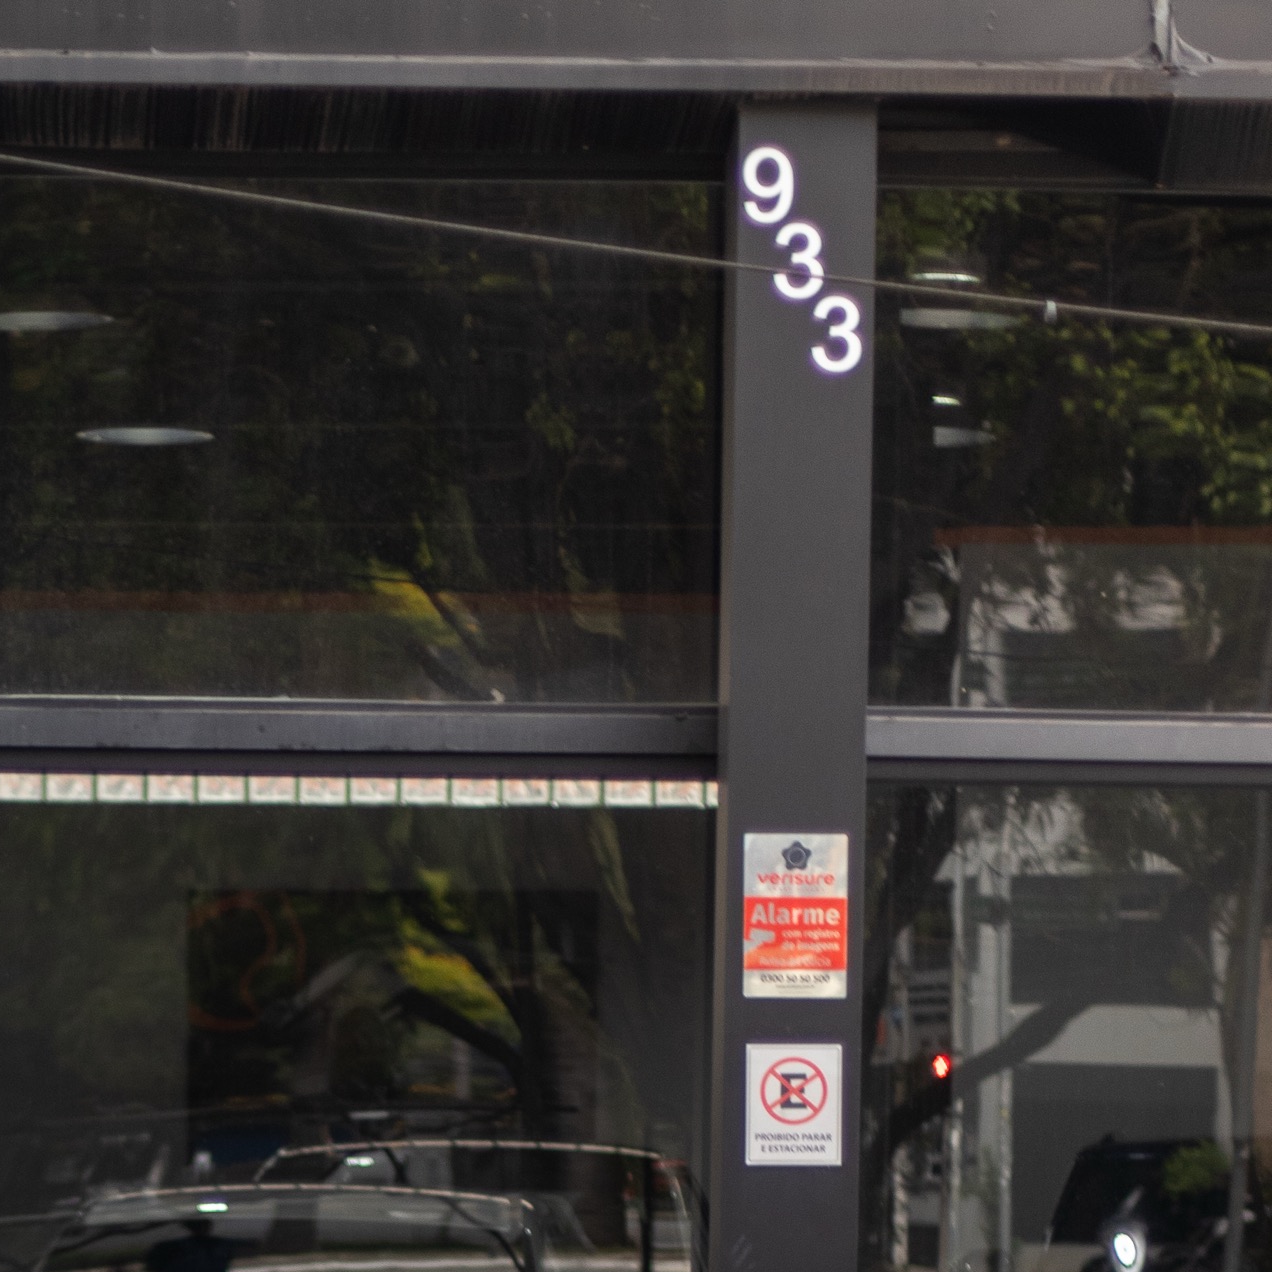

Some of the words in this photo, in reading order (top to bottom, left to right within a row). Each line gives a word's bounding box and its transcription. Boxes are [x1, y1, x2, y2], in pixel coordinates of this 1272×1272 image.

[742, 146, 863, 373] 933
[757, 872, 835, 885] verisure
[750, 903, 841, 926] Alarme
[755, 1133, 800, 1142] PROIBIDO
[802, 1133, 832, 1142] PARAR
[761, 1145, 766, 1153] E
[768, 1145, 826, 1153] ESTACIONAR
